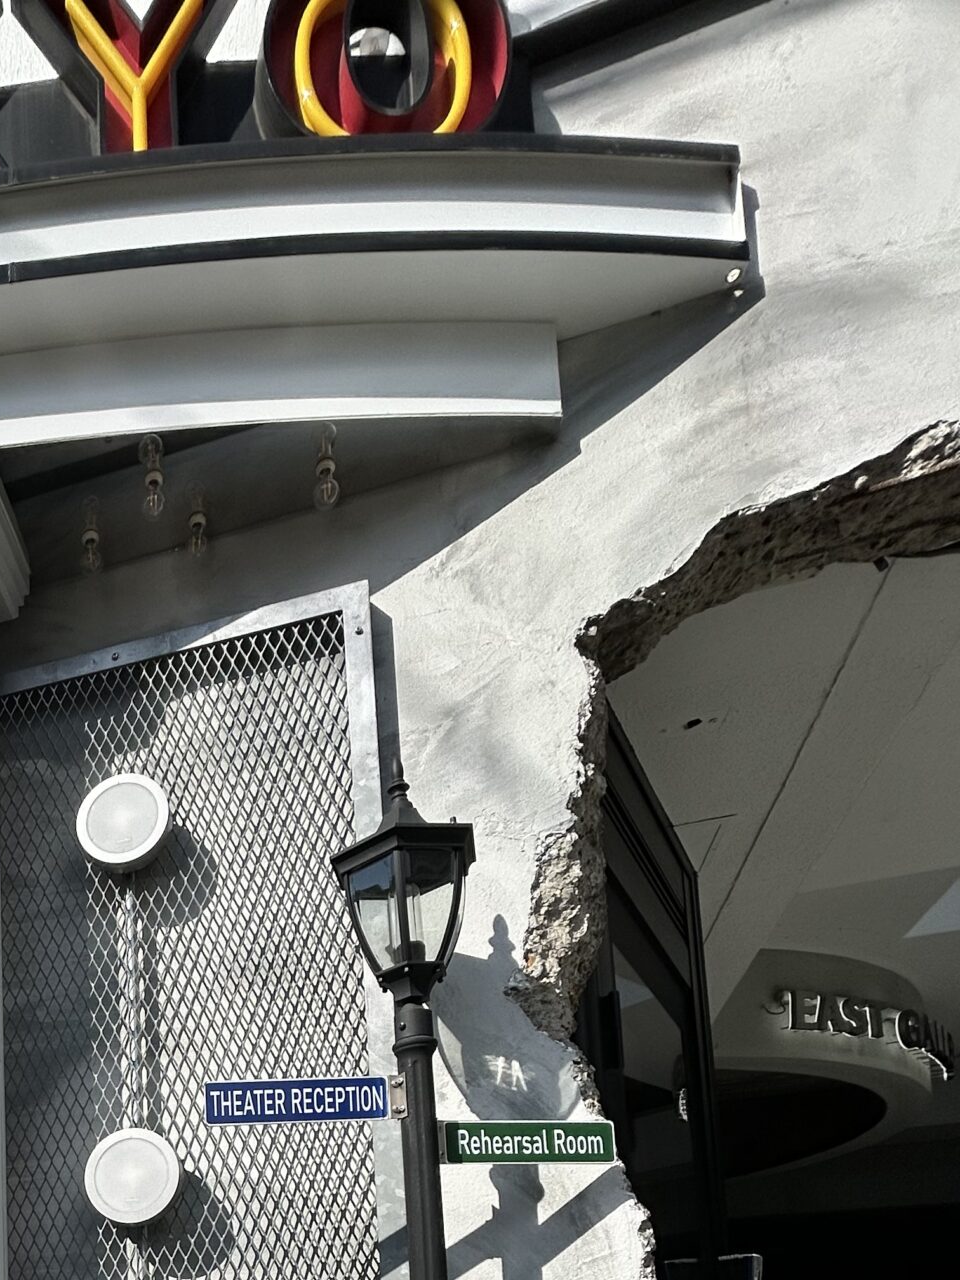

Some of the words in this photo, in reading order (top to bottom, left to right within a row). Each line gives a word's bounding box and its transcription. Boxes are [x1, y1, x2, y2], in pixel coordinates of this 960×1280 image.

[787, 990, 885, 1040] EAST
[209, 1087, 286, 1117] THEATER
[290, 1084, 385, 1114] RECEPTION
[457, 1128, 549, 1156] Rehearsal
[554, 1128, 604, 1155] Room
